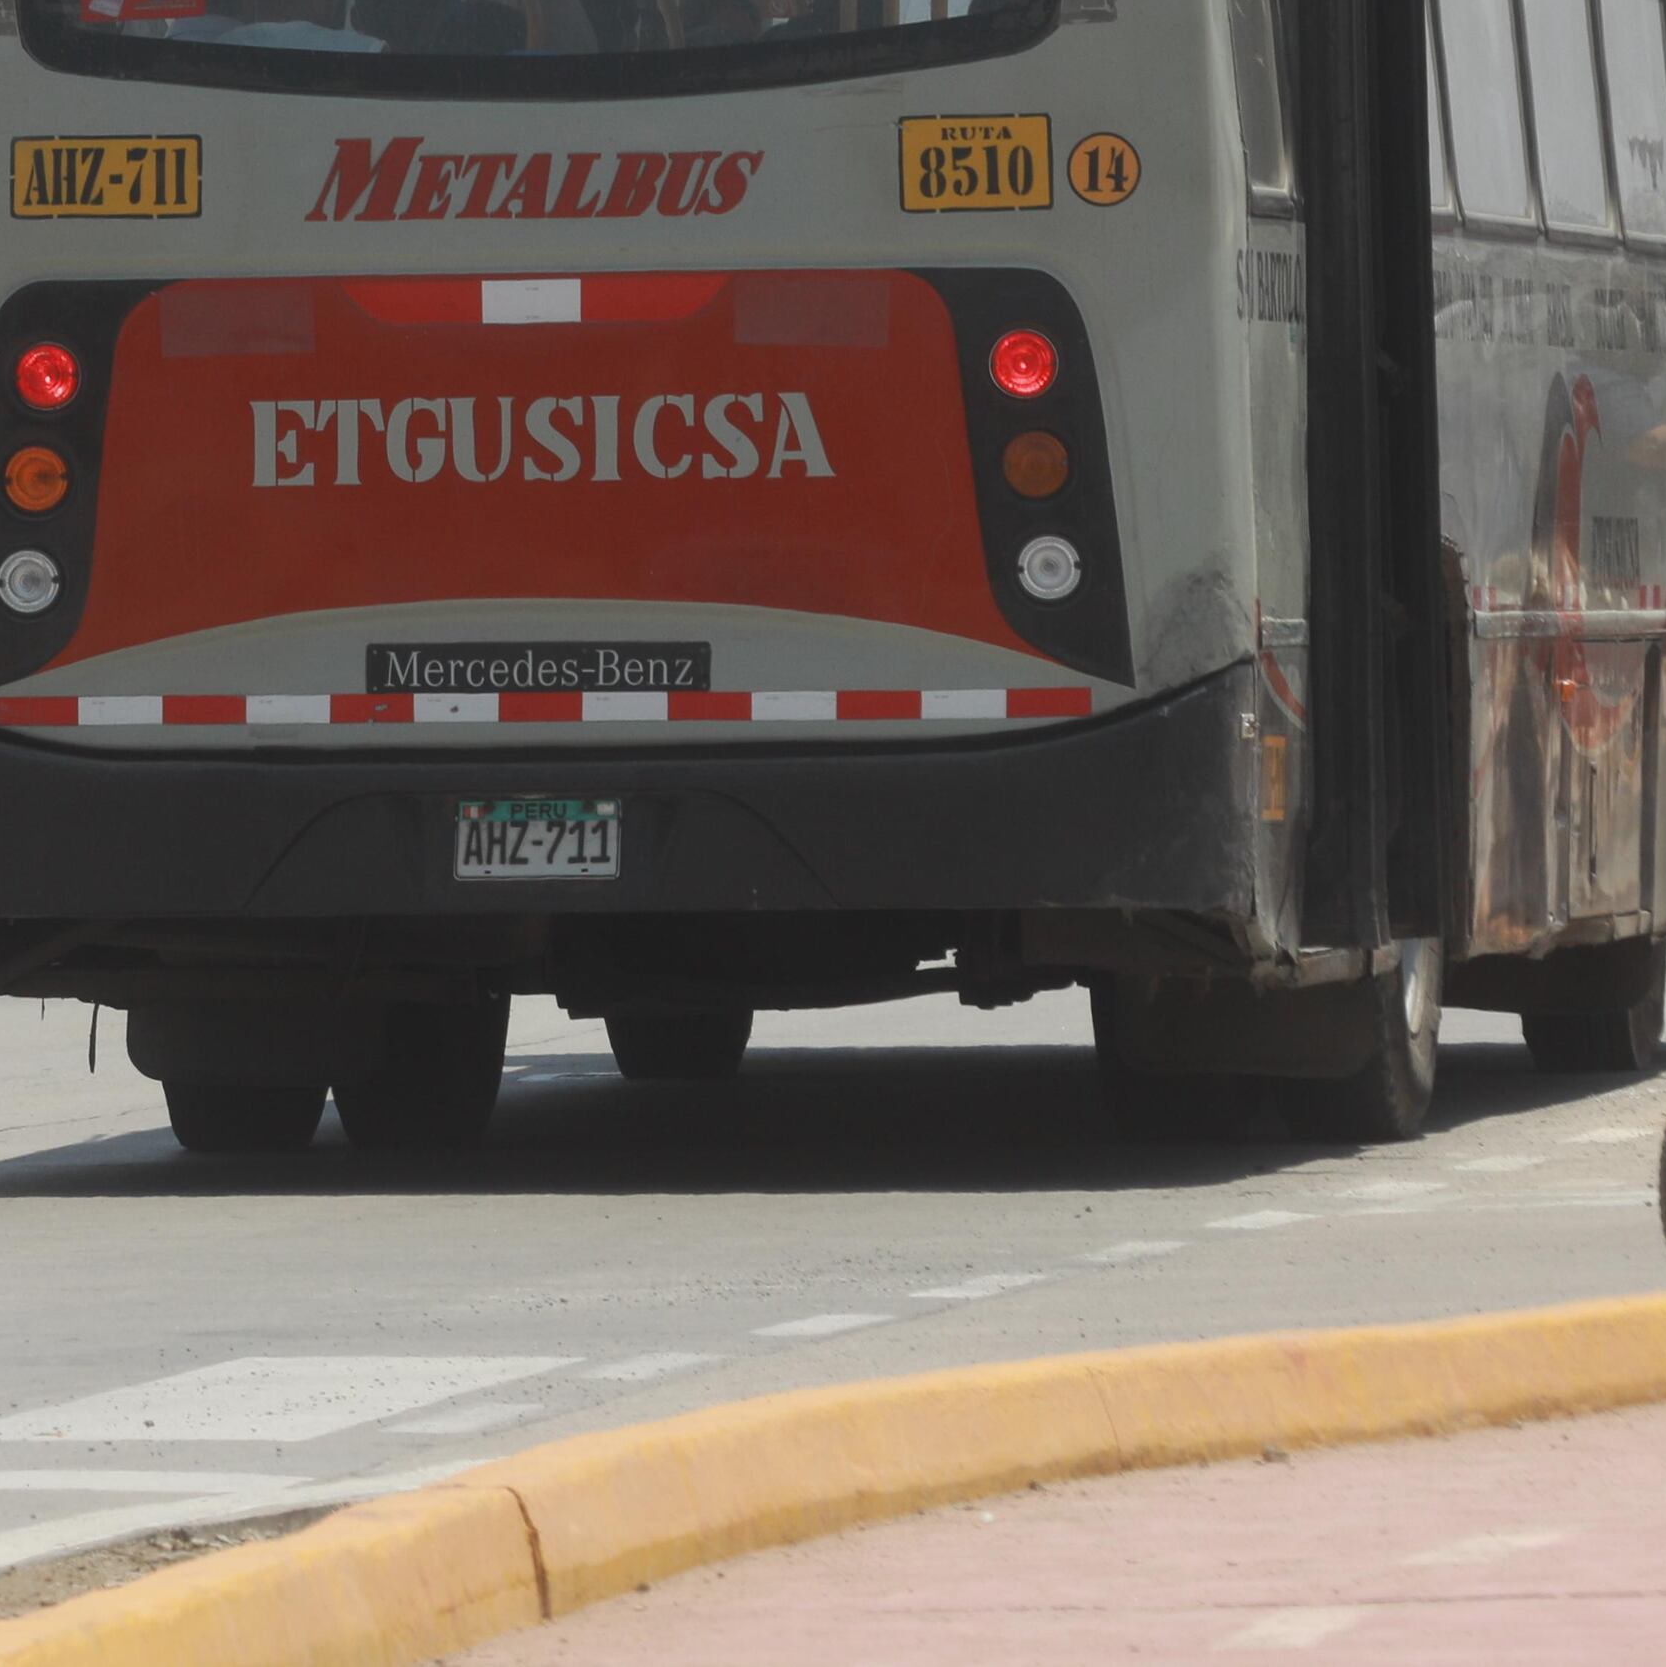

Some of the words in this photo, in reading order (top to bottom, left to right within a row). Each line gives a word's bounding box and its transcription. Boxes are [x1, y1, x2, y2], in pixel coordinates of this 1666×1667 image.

[941, 126, 1013, 141] RUTA
[23, 146, 187, 206] AHZ-711
[305, 136, 764, 222] METALBUS
[918, 144, 1033, 198] 8510
[1082, 145, 1130, 194] 14
[249, 392, 837, 488] ETGUSICSA
[385, 649, 694, 689] Mercedes-Benz
[510, 803, 567, 820] PERU
[463, 820, 611, 866] AHZ-711
